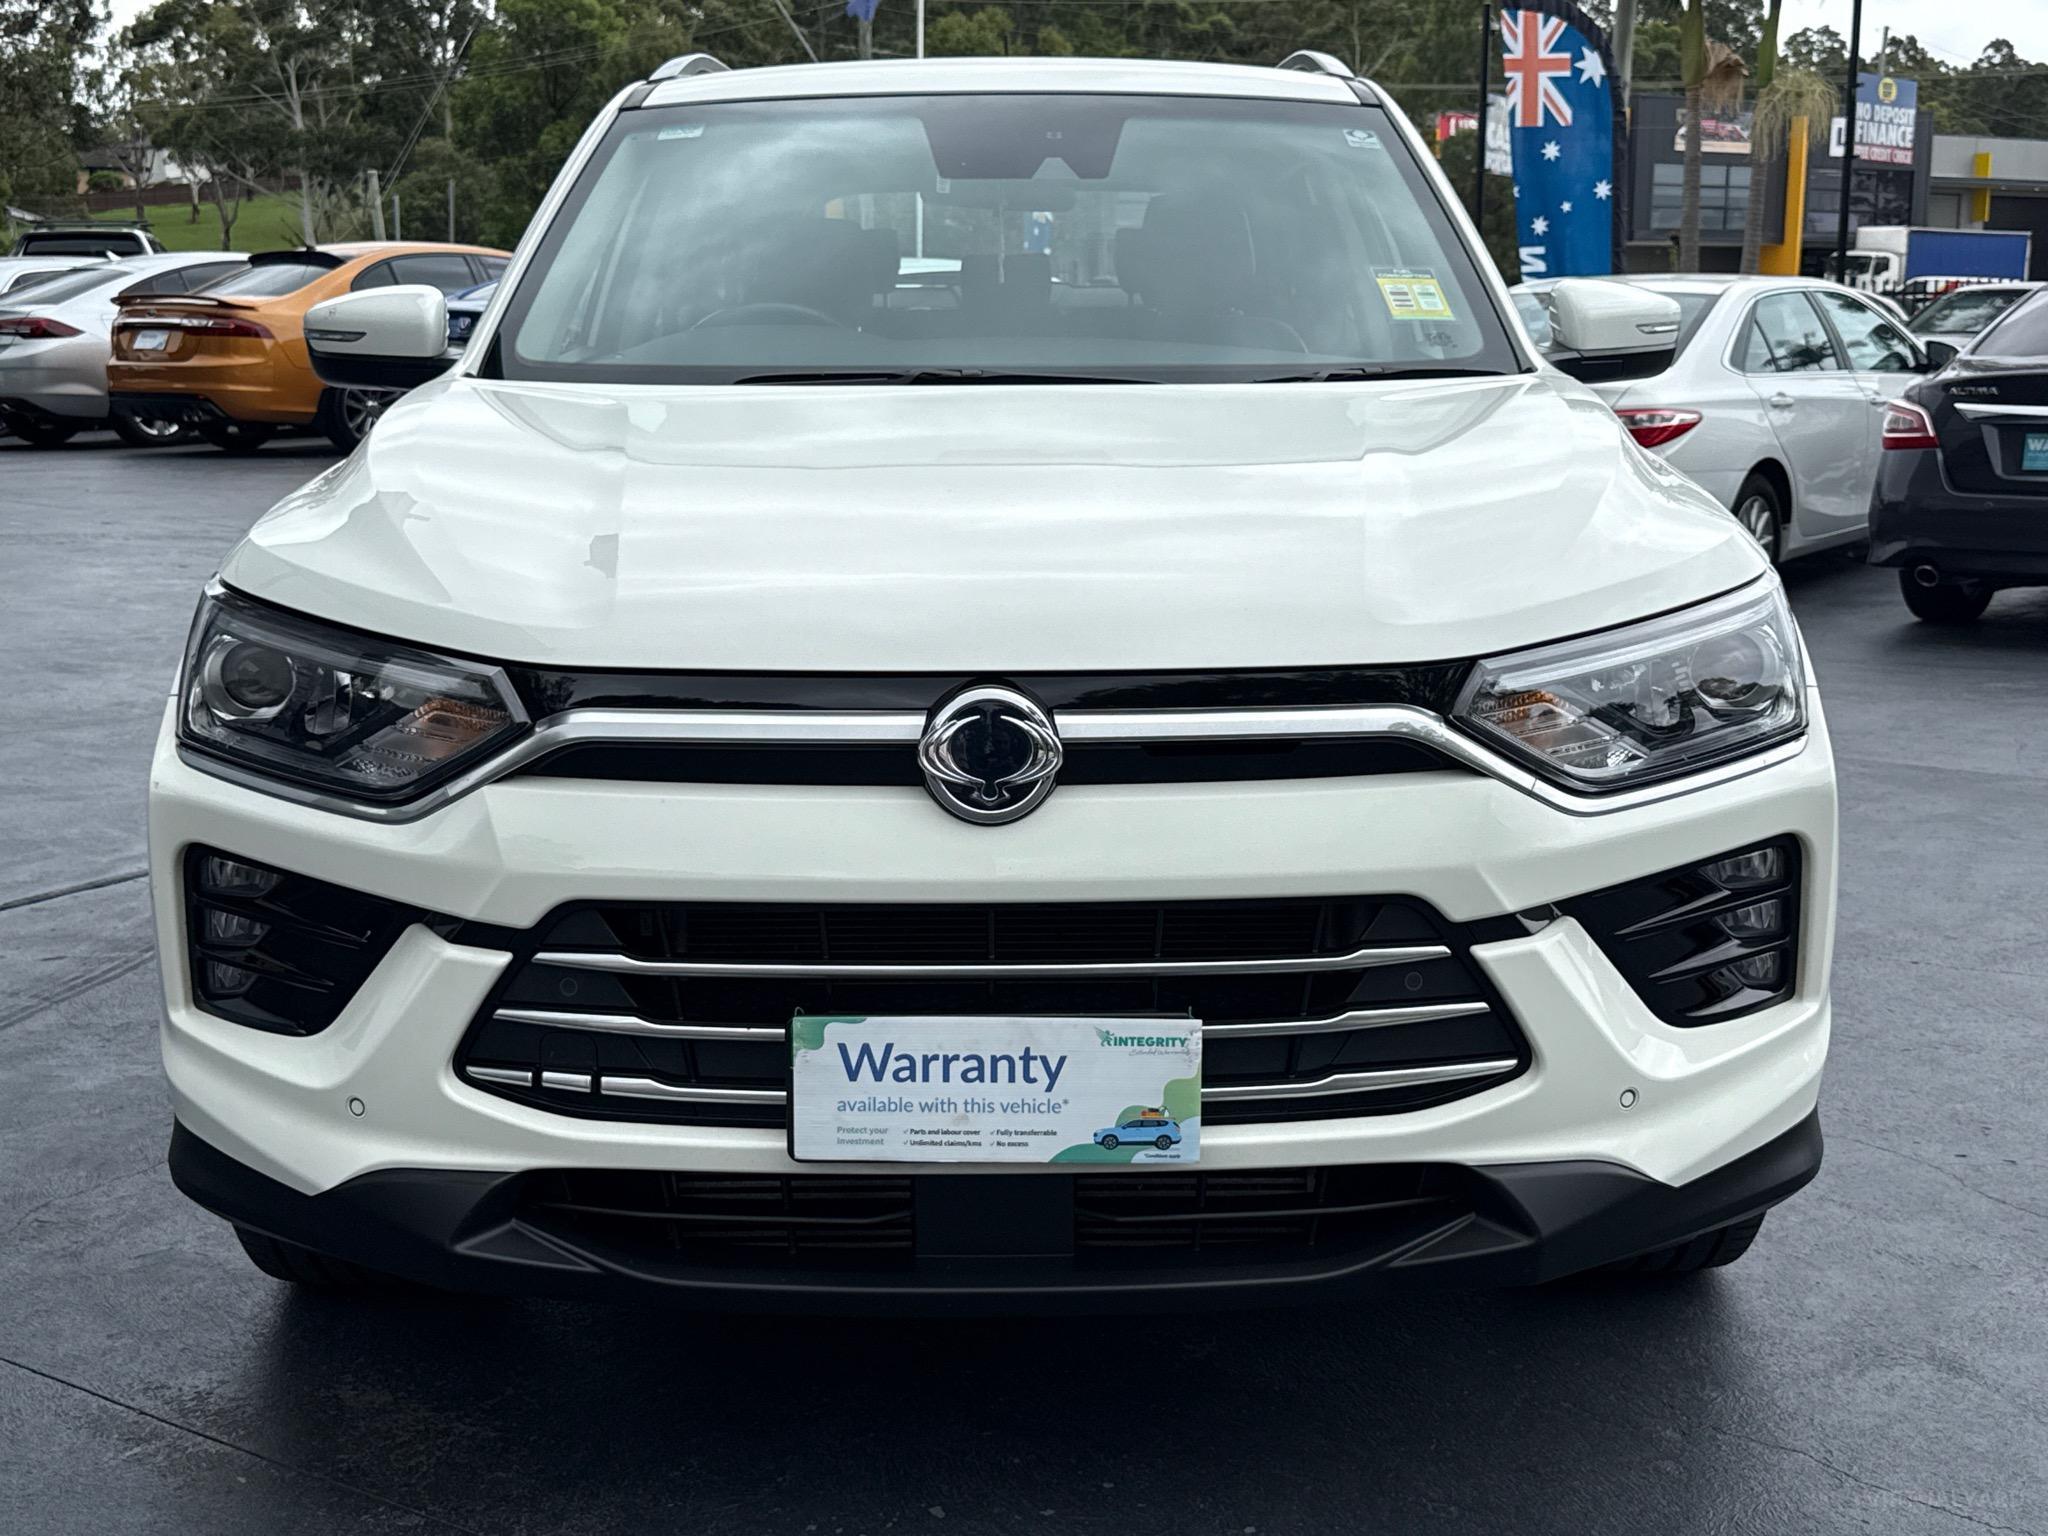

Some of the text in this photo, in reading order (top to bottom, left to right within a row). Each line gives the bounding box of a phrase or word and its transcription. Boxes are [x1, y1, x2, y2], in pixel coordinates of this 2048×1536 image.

[1855, 102, 1917, 127] NO DEPOSIT
[1854, 121, 1915, 149] FINANCE
[1949, 386, 1999, 396] ALTIMA
[1113, 1036, 1189, 1047] INTEGRITY
[837, 1042, 1068, 1093] Warranty
[837, 1097, 914, 1113] available
[918, 1097, 958, 1113] with
[963, 1097, 996, 1113] this
[837, 1126, 888, 1137] Protect your
[996, 1129, 1013, 1138] Fully
